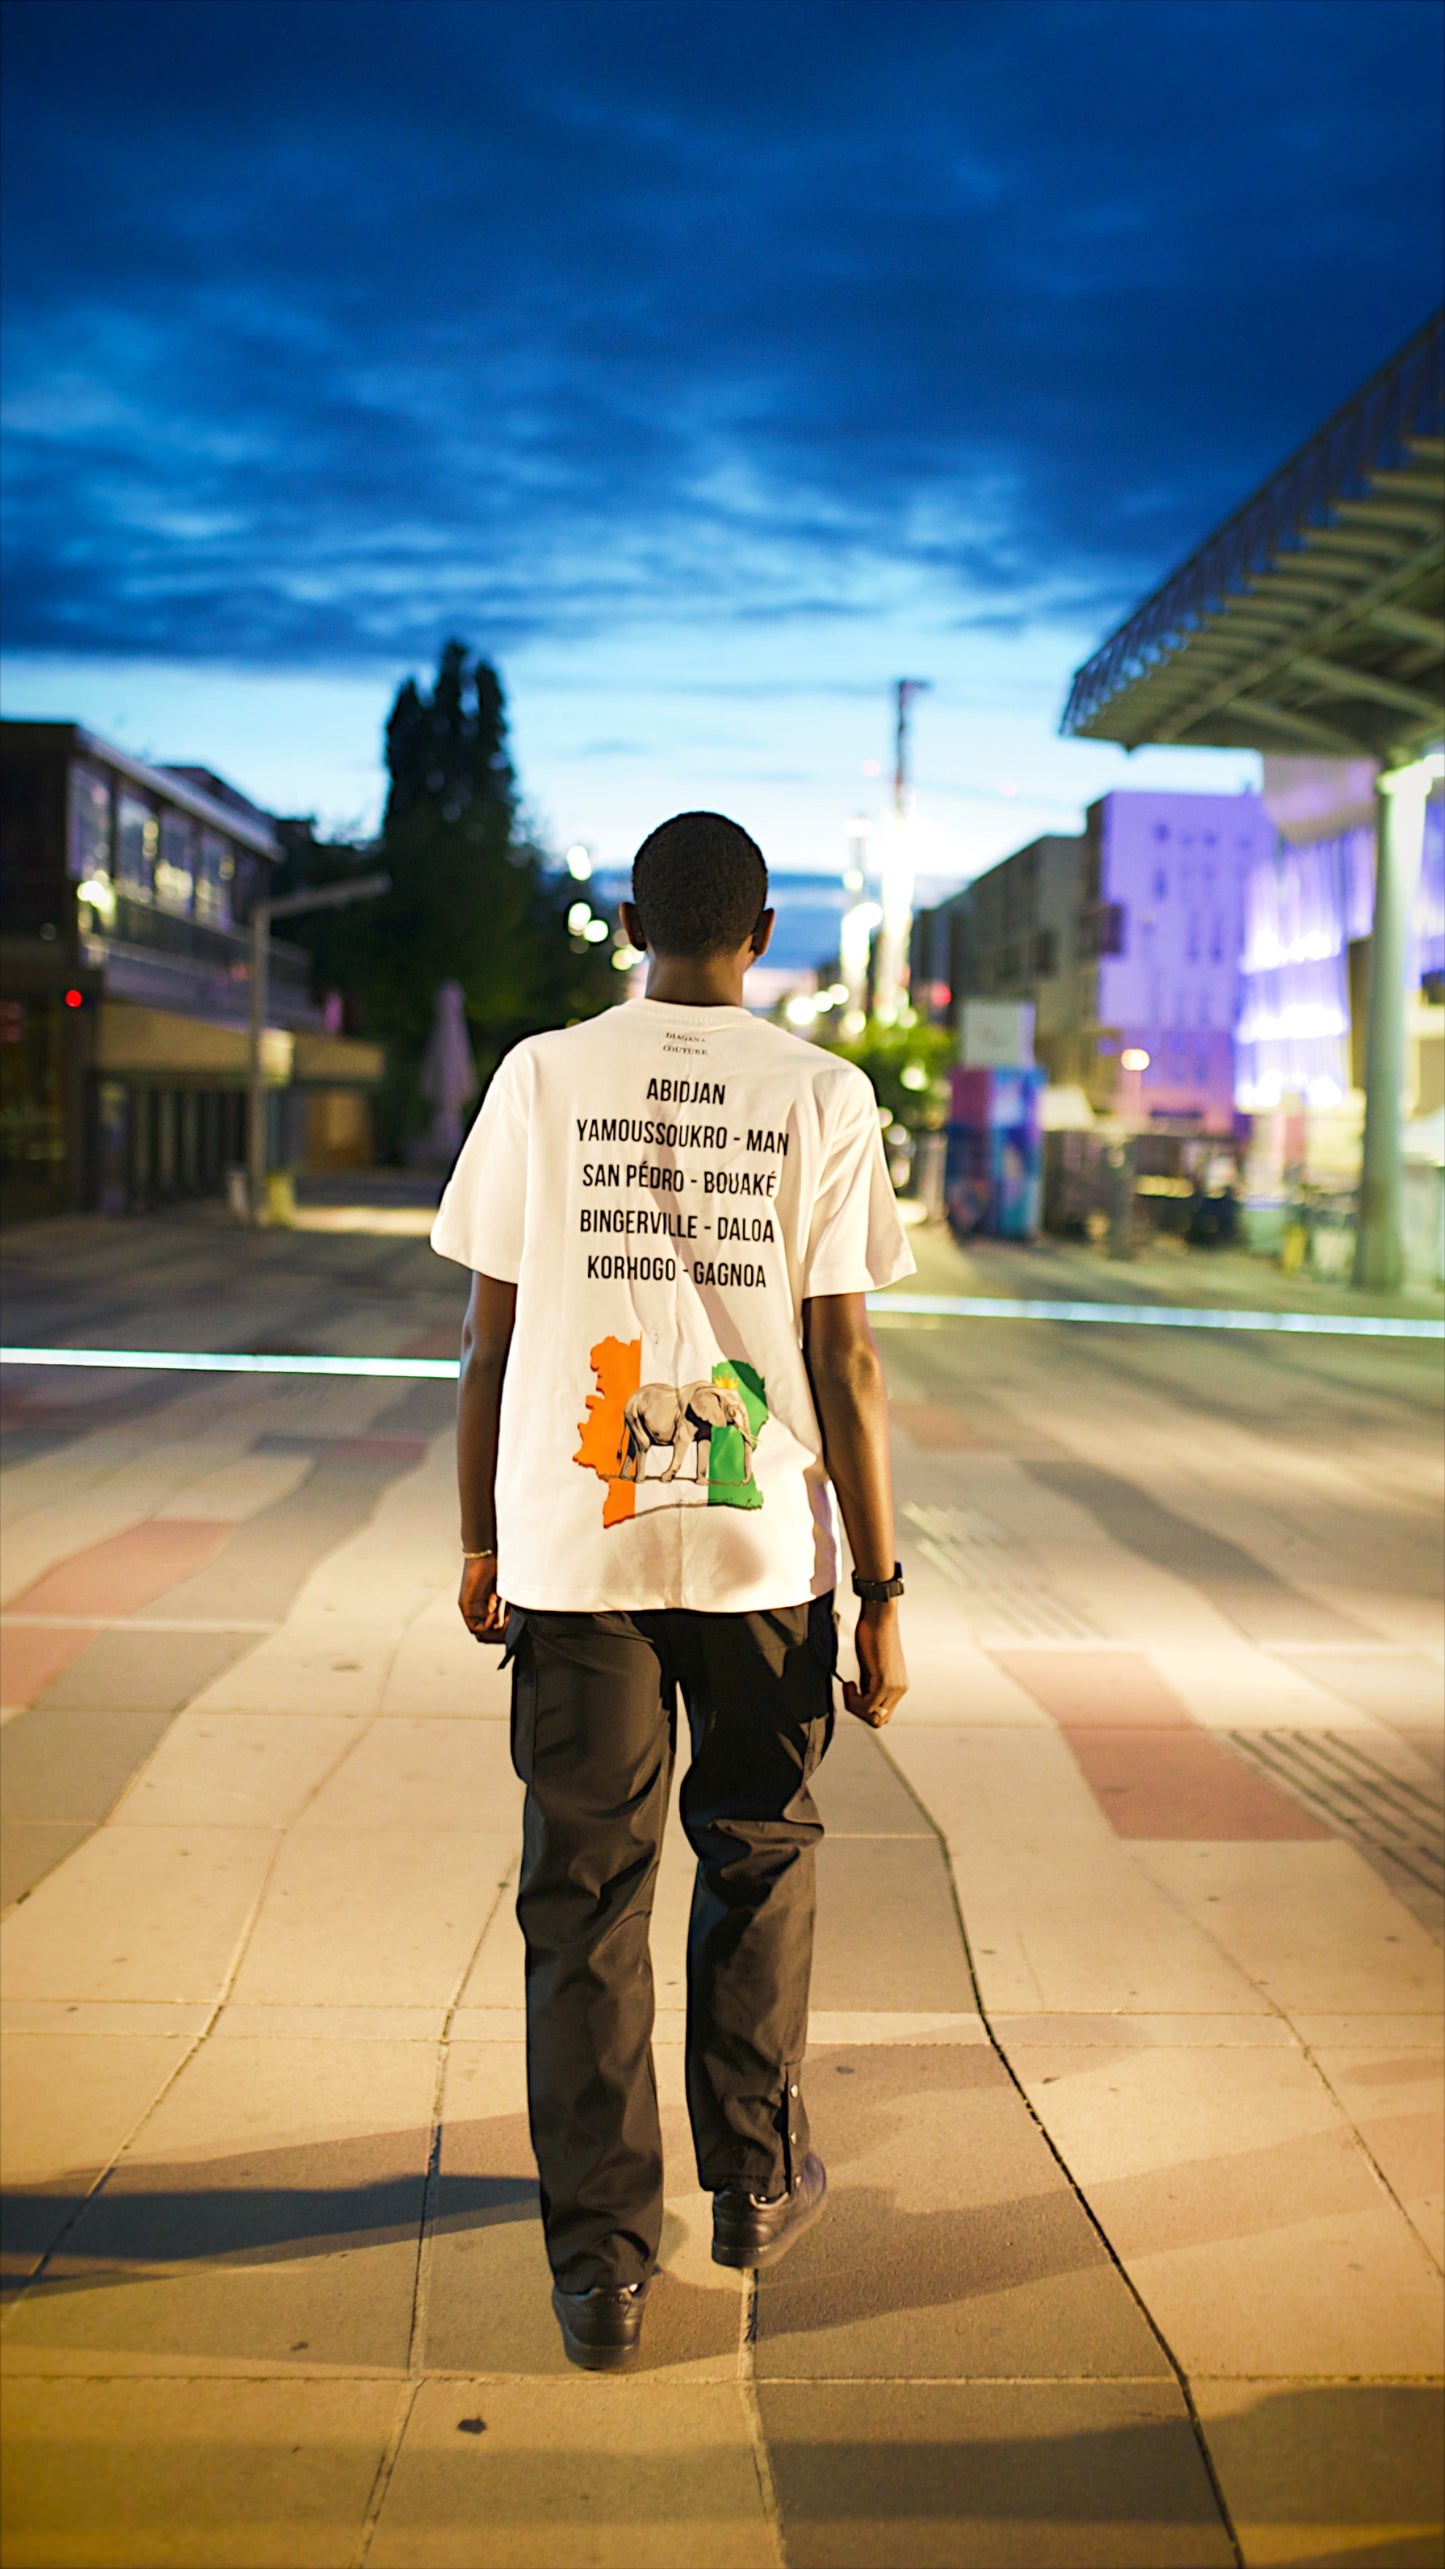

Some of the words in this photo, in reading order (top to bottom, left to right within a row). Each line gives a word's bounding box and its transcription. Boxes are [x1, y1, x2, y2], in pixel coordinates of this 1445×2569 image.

[646, 1078, 726, 1105] ABIDJAN
[576, 1119, 727, 1149] YAMOUSSOUKRO
[746, 1129, 789, 1156] MAN
[582, 1164, 620, 1187] SAN
[626, 1160, 684, 1192] PÉDRO
[704, 1171, 777, 1197] BOUAKÉ
[580, 1209, 698, 1239] BINGERVILLE
[717, 1217, 775, 1243] DALOA
[587, 1255, 676, 1281] KORHOGO
[693, 1261, 766, 1288] GAGNOA
